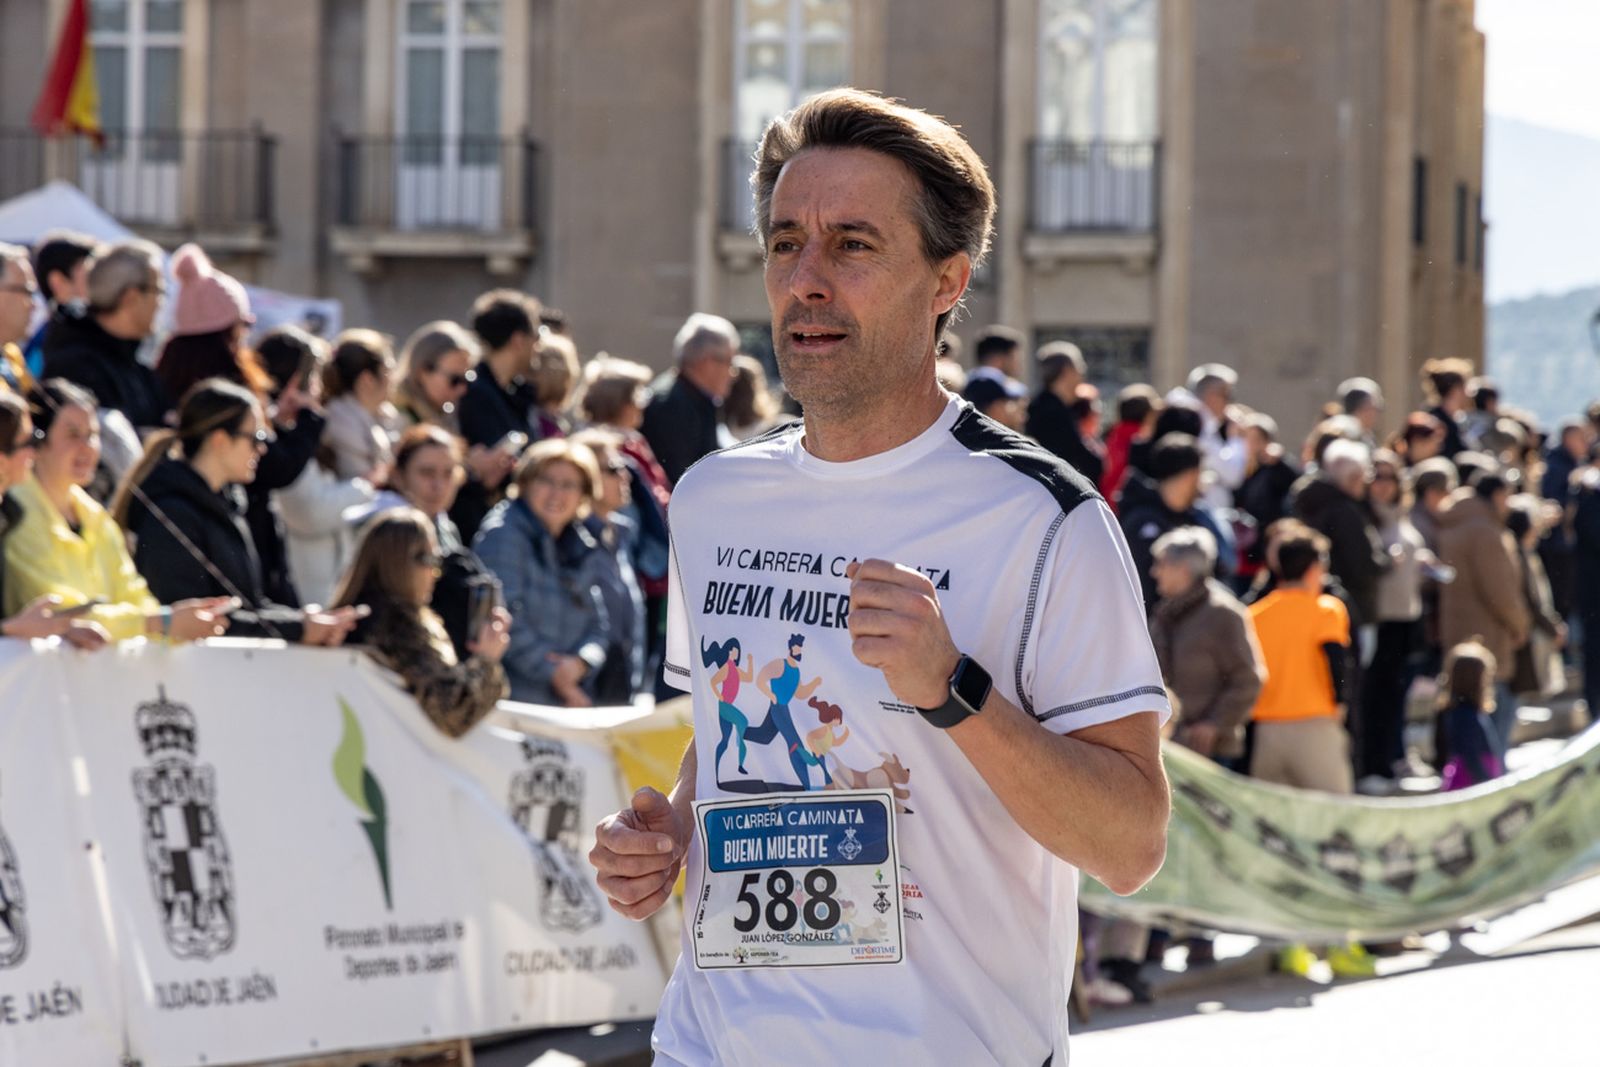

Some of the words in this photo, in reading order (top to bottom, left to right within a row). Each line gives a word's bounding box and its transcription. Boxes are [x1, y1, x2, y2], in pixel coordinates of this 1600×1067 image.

[717, 546, 735, 567] VI
[737, 548, 823, 575] CARRERA
[703, 581, 775, 619] BUENA
[779, 588, 850, 629] MUER
[722, 816, 734, 831] VI
[735, 812, 784, 830] CARRERA
[788, 808, 864, 826] CAMINATA
[723, 837, 763, 864] BUENA
[767, 834, 829, 861] MUERTE
[734, 868, 841, 932] 588
[741, 934, 760, 943] JUAN
[761, 932, 785, 942] LÓPEZ
[787, 930, 834, 942] GONZÁLEZ
[0, 994, 19, 1025] E
